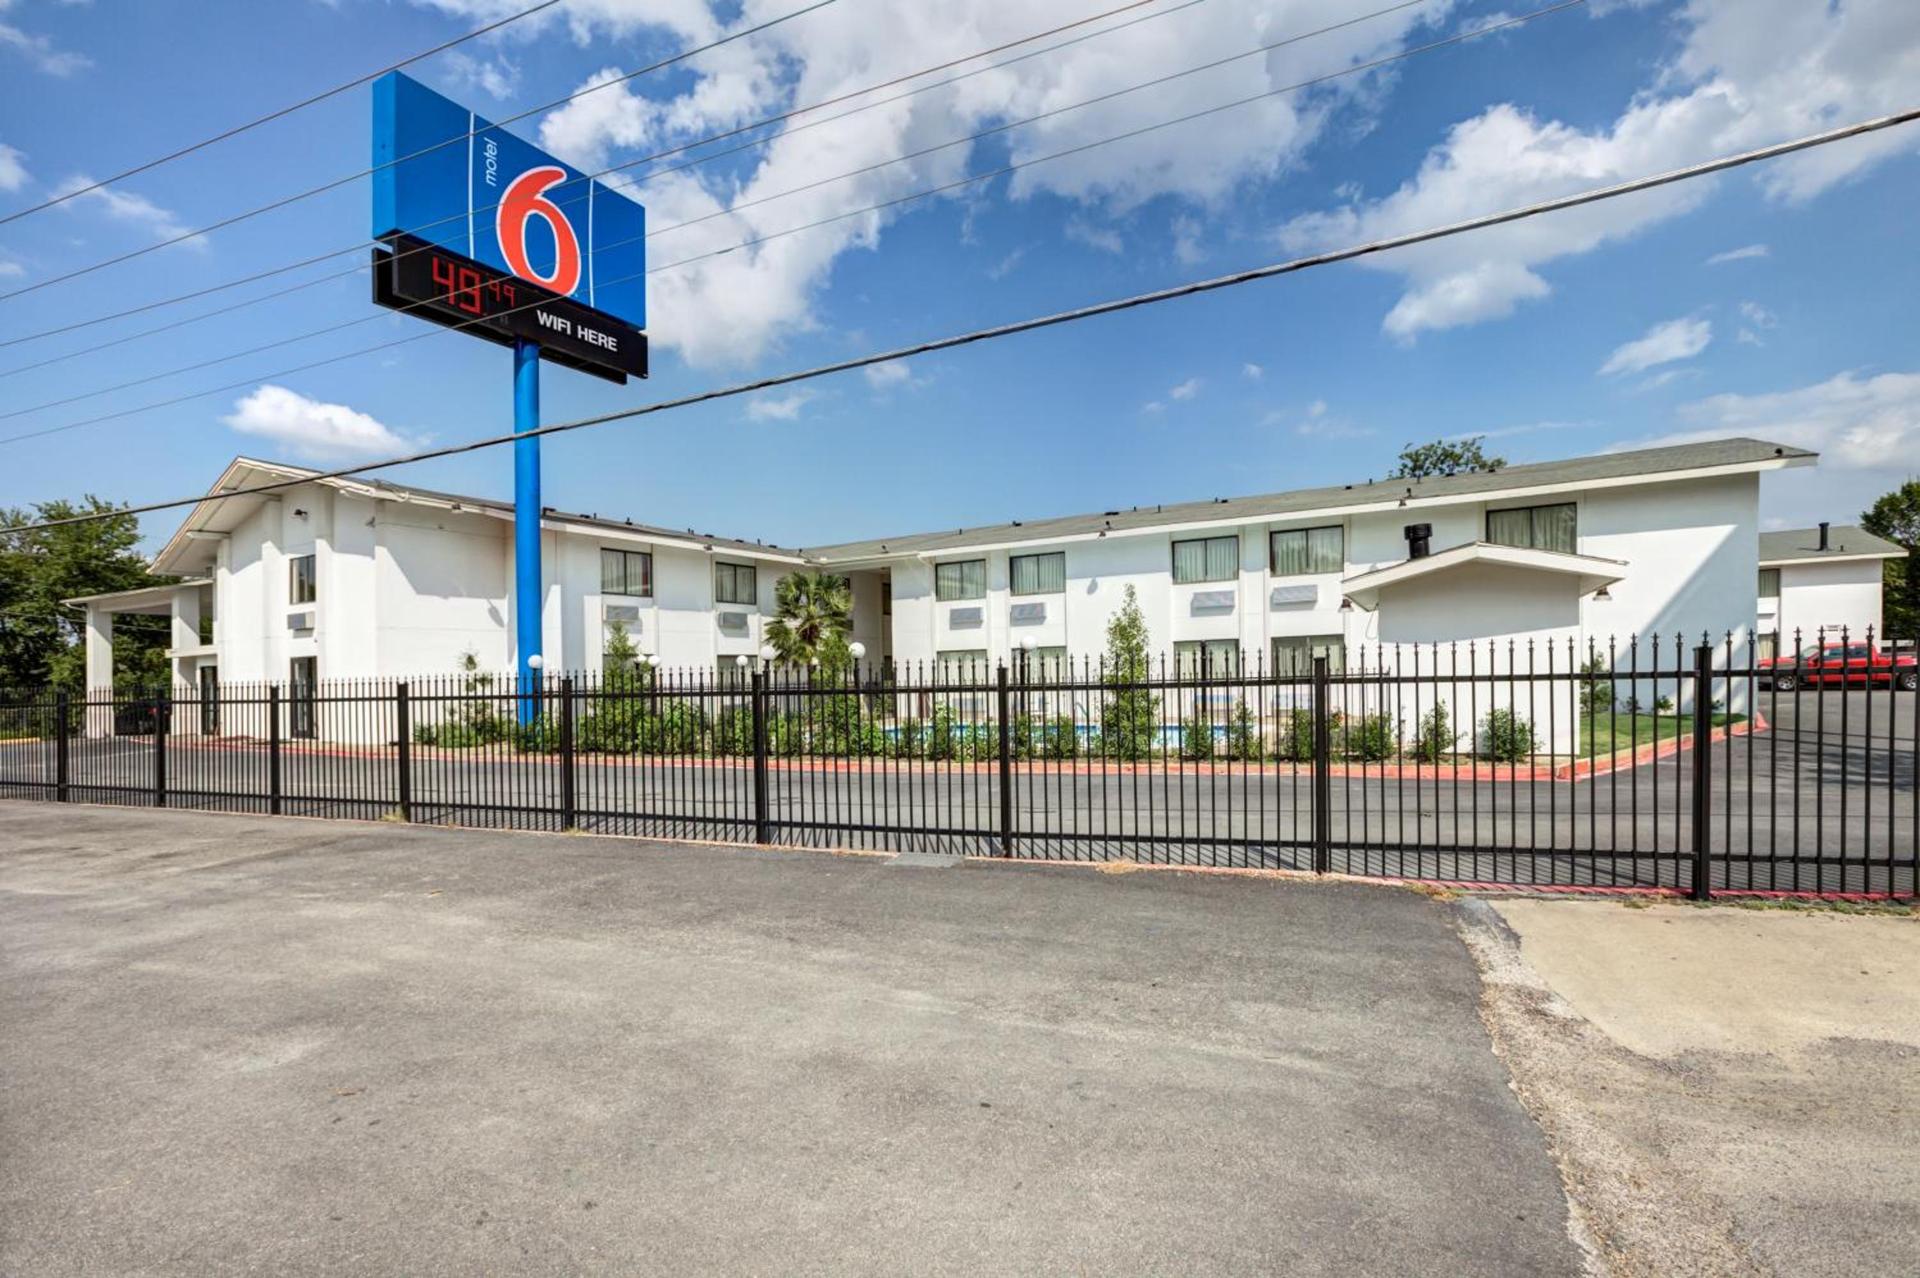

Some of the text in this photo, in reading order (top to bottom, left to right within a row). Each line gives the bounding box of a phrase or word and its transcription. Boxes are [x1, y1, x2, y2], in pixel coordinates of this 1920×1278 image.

[484, 137, 497, 187] motel
[495, 165, 582, 297] 6
[432, 255, 481, 315] 49
[536, 309, 618, 353] WIFI HERE
